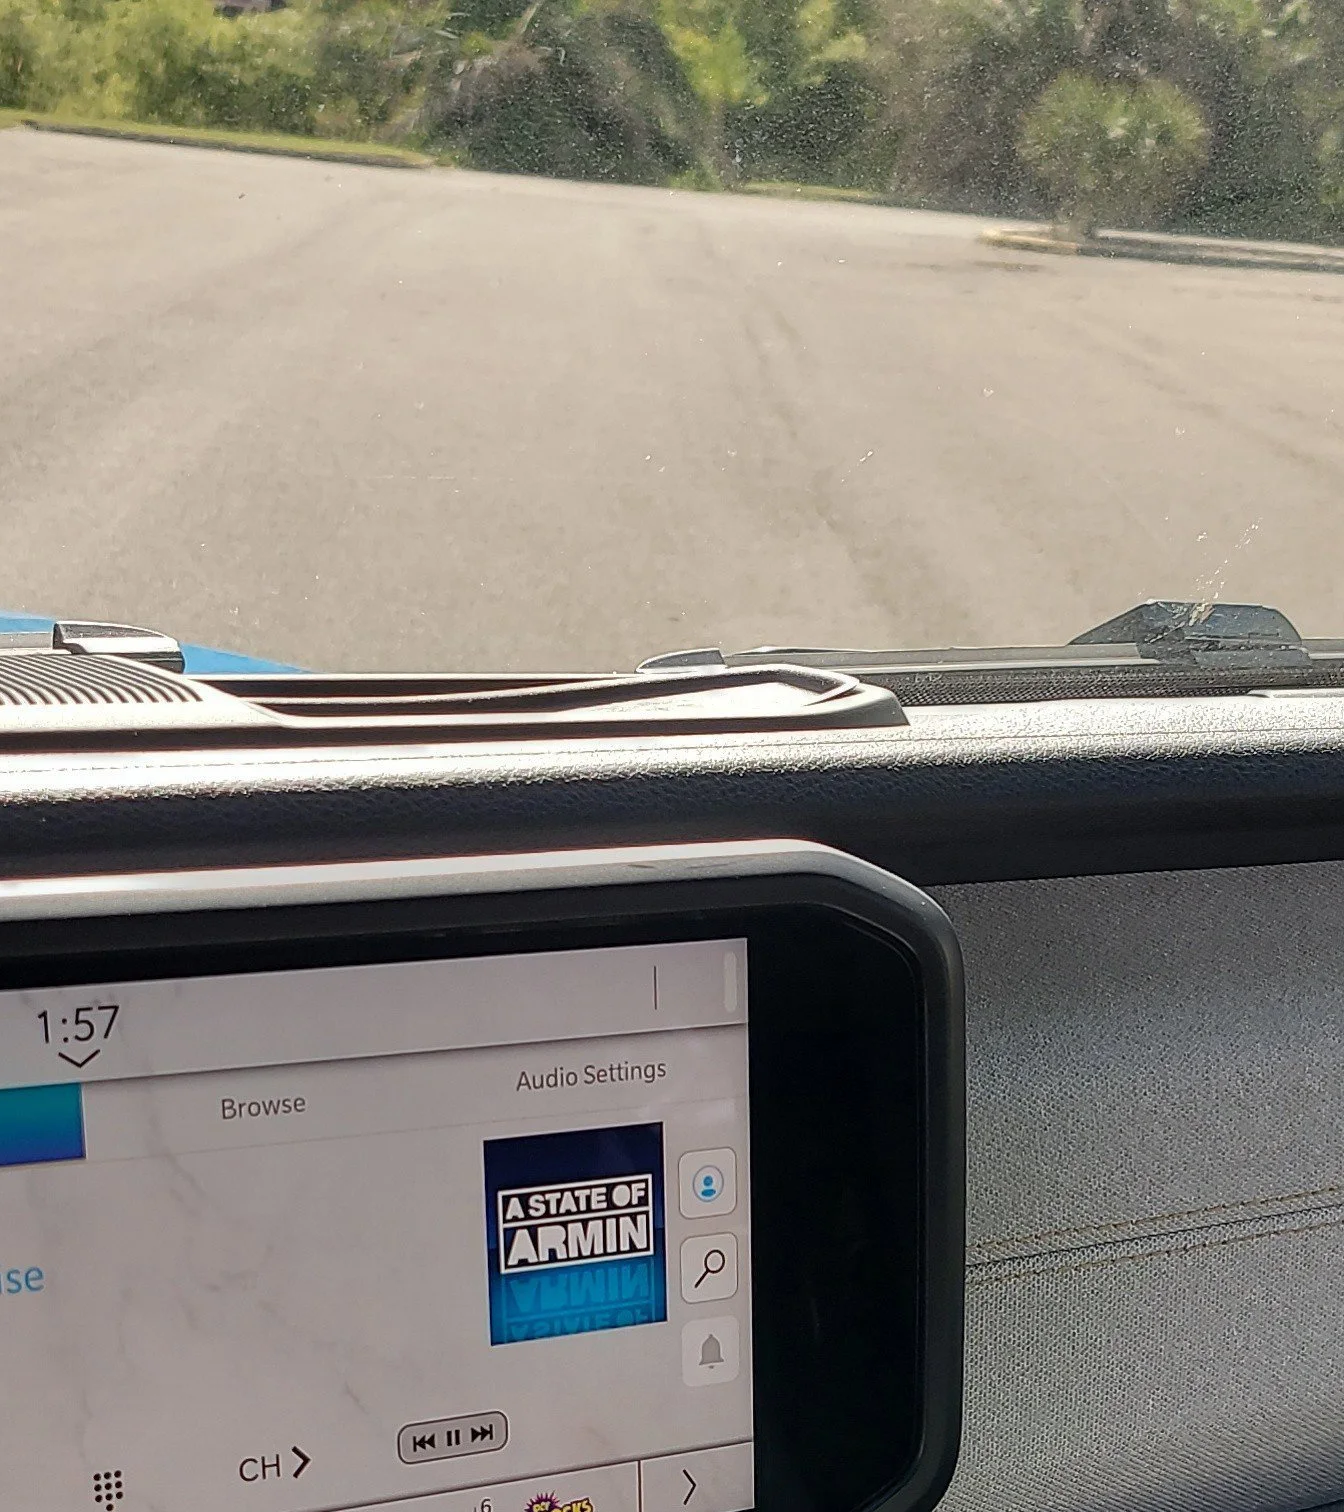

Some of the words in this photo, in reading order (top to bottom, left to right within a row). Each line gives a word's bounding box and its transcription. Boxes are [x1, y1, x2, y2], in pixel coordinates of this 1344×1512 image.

[36, 1005, 120, 1045] 1:57
[515, 1066, 579, 1092] Audio
[582, 1059, 667, 1089] Settings
[221, 1094, 307, 1121] Browse
[506, 1197, 525, 1220] A
[527, 1187, 607, 1217] STATE
[612, 1182, 646, 1207] OF
[507, 1214, 647, 1266] ARMIN
[239, 1453, 281, 1483] CH
